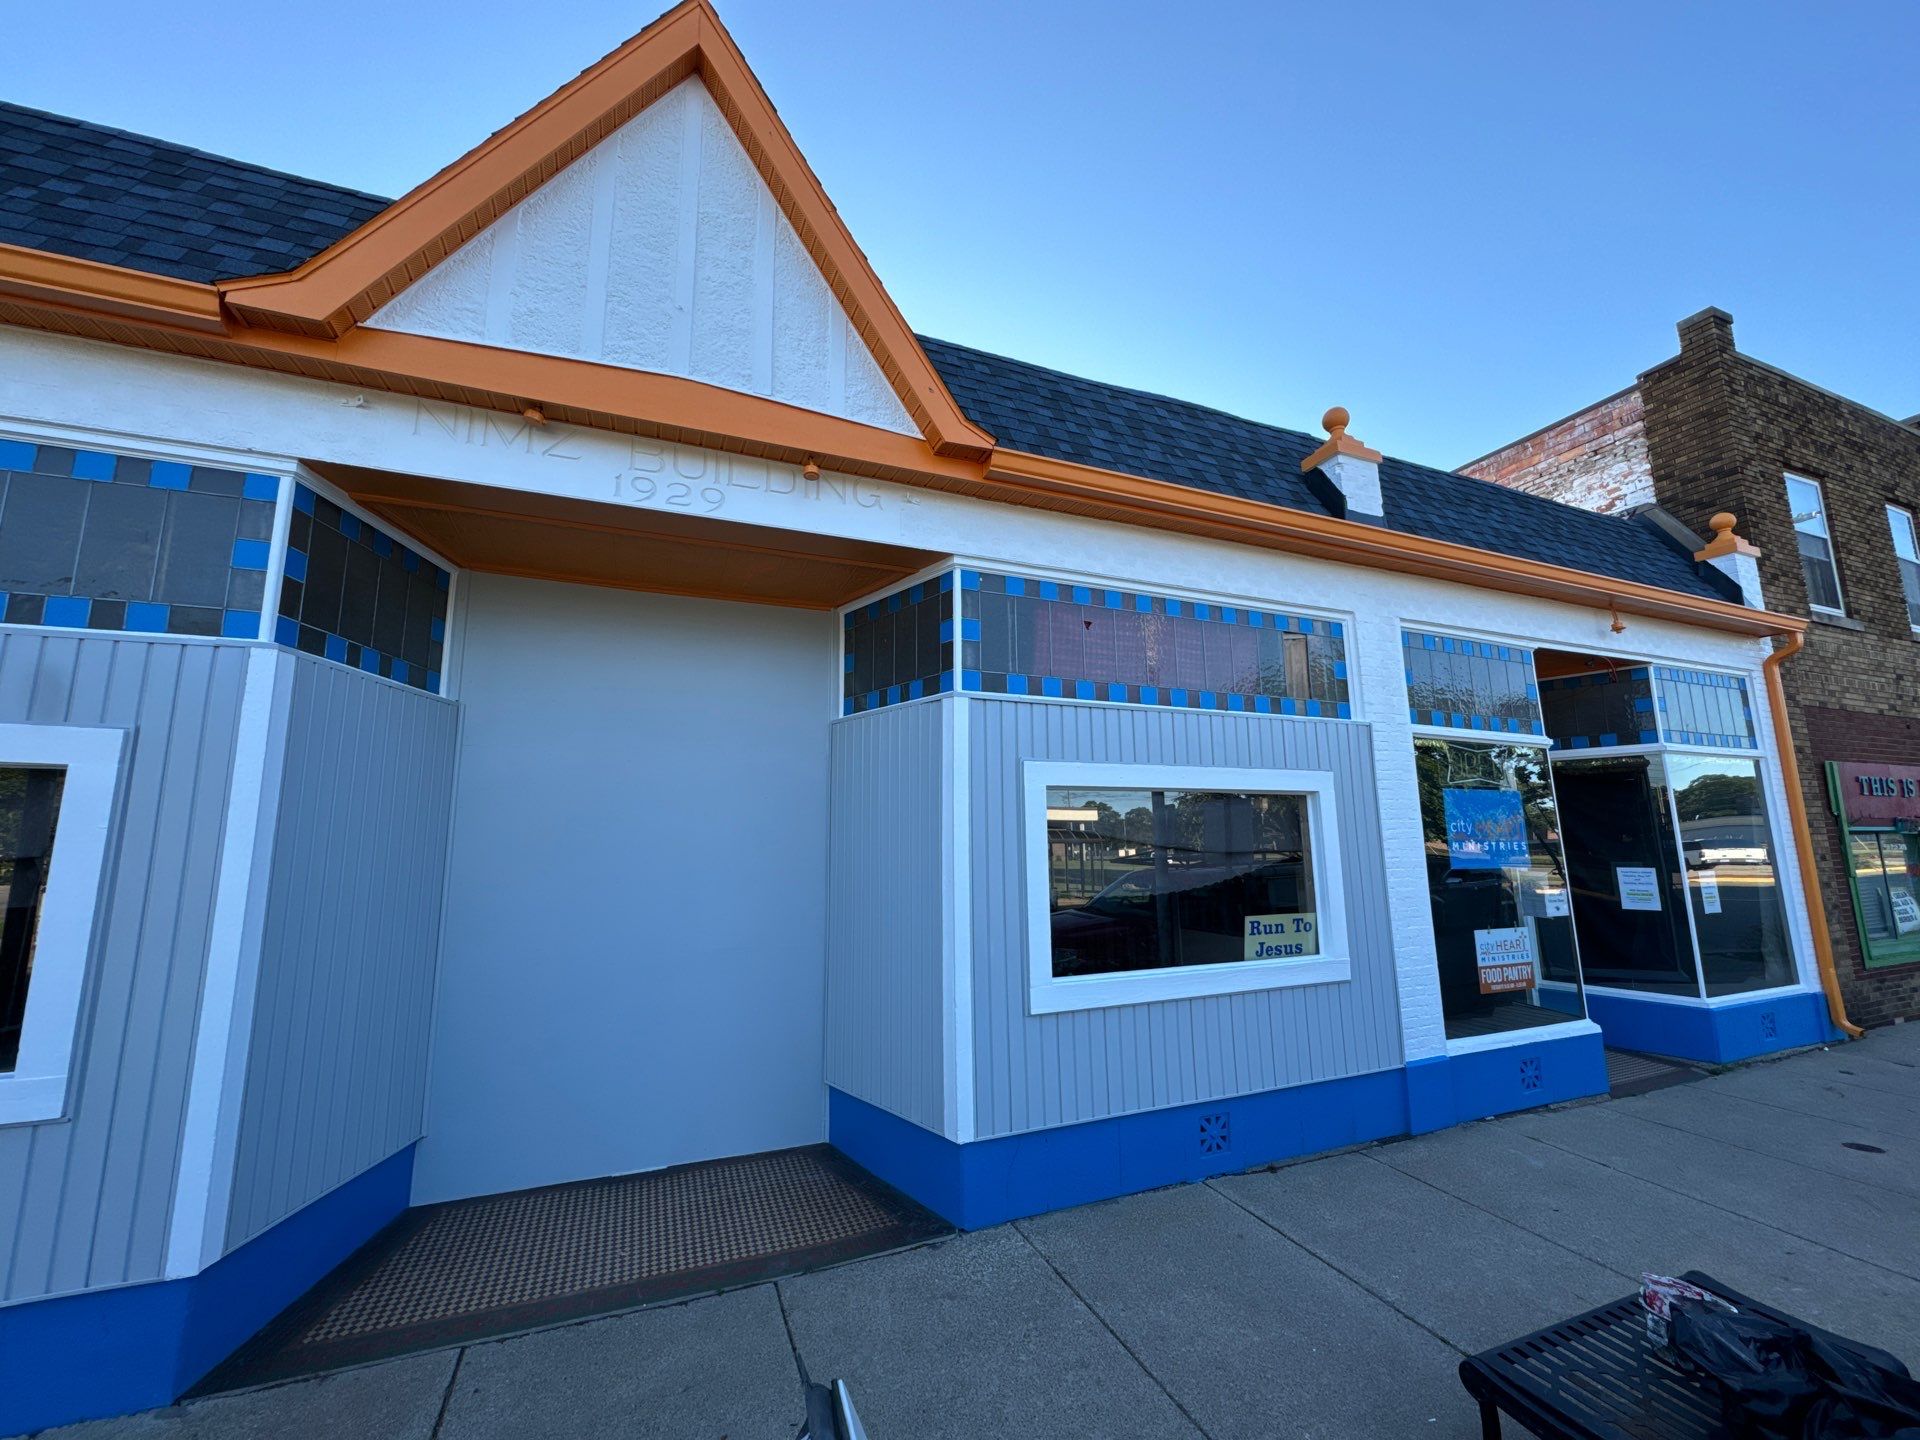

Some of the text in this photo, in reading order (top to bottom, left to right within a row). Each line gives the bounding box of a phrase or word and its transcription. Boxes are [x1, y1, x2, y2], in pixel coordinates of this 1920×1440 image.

[412, 399, 884, 511] NIMZ BUILDING
[613, 474, 726, 513] 1929
[1855, 775, 1916, 799] THIS IS
[1450, 819, 1473, 835] city
[1452, 841, 1528, 853] MINISTRIES
[1248, 917, 1312, 936] Run To
[1255, 941, 1304, 957] Jesus
[1480, 952, 1530, 963] MINISTRIES
[1481, 964, 1532, 984] FOOD PANTRY
